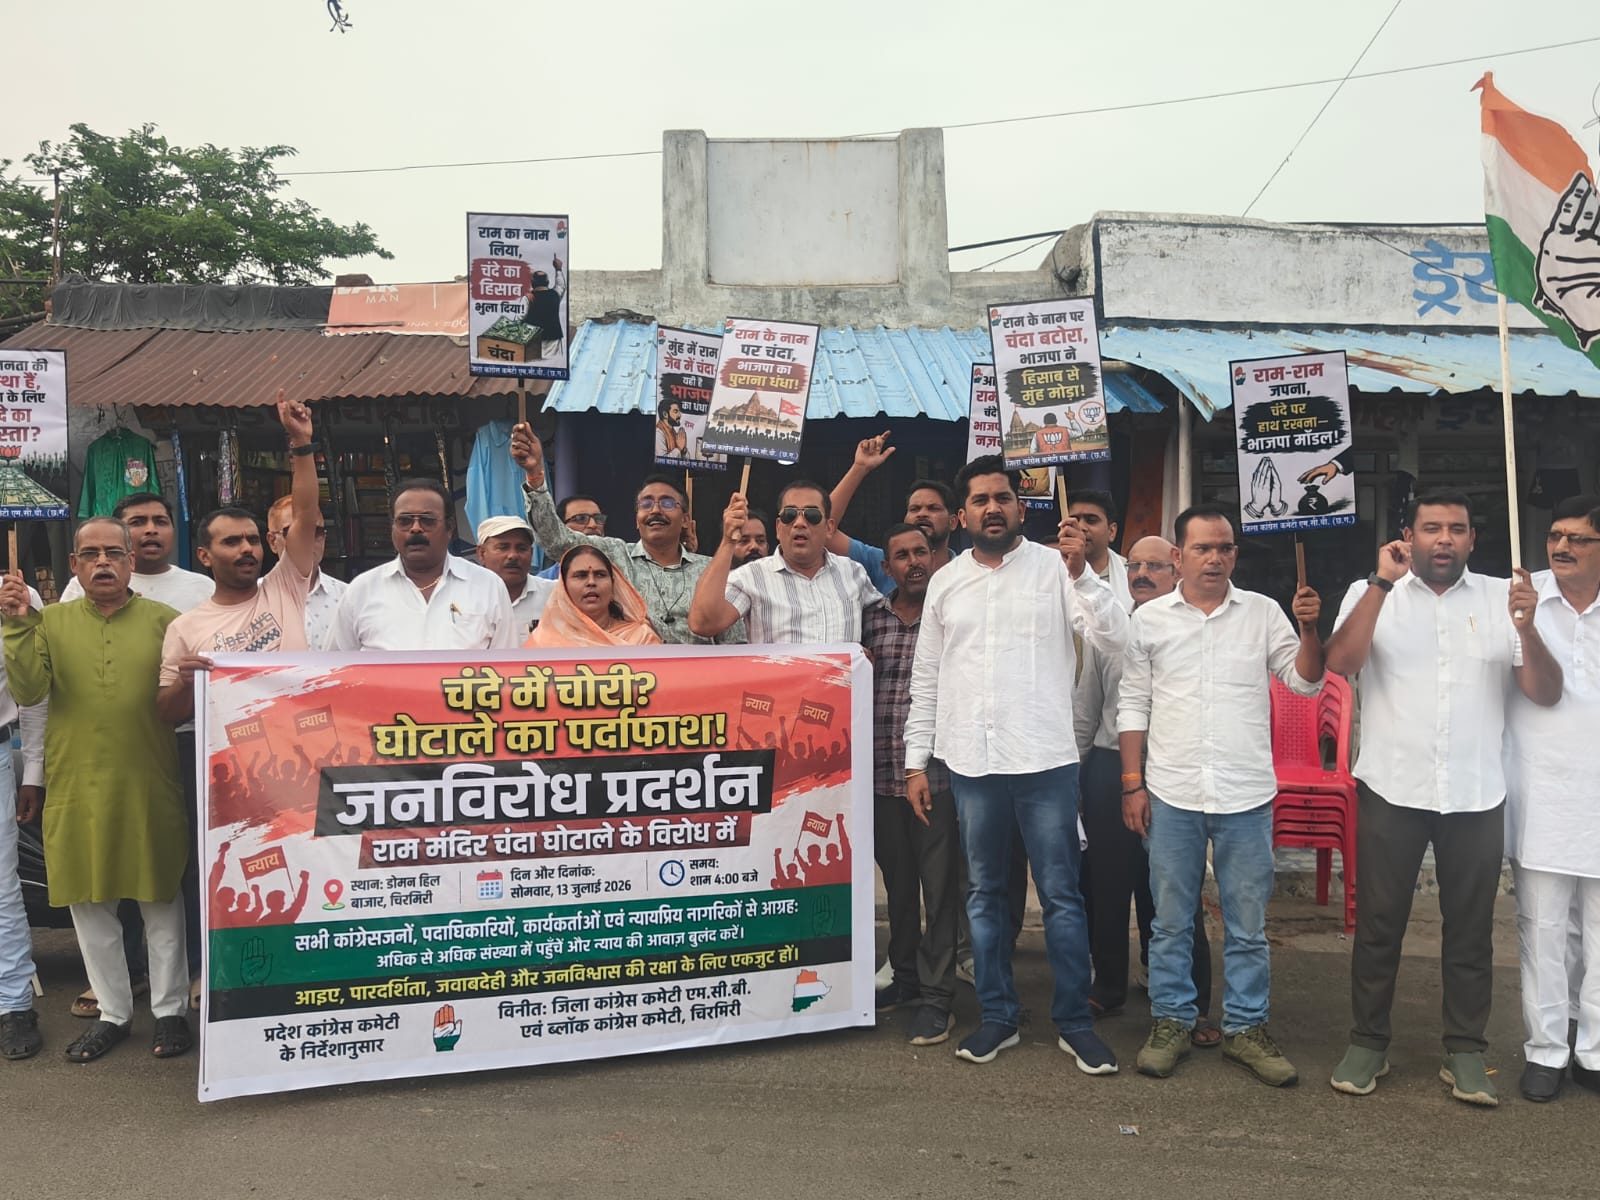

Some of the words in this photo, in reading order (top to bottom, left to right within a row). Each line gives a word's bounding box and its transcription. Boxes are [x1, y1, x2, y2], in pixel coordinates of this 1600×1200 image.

[478, 226, 502, 239] राम
[504, 227, 520, 240] का
[523, 228, 550, 241] नाम
[489, 241, 523, 259] लिया,
[480, 261, 501, 278] चंदे
[503, 264, 521, 278] का
[480, 278, 523, 296] हिसाब
[366, 295, 399, 304] MAN
[475, 302, 498, 315] भुला
[500, 302, 525, 314] दिया!
[1003, 315, 1024, 328] राम
[1027, 312, 1038, 326] के
[1041, 312, 1068, 324] नाम
[1069, 311, 1085, 322] पर
[735, 328, 759, 341] राम
[763, 328, 776, 341] के
[779, 333, 810, 345] नाम
[1005, 331, 1035, 348] चंदा
[1039, 327, 1088, 346] बटोरा,
[488, 343, 516, 361] चंदा
[668, 338, 685, 356] मुंह
[687, 341, 698, 356] में
[699, 345, 718, 359] राम
[741, 343, 762, 355] पर
[765, 345, 797, 362] चंदा,
[1019, 350, 1061, 365] भाजपा
[1064, 346, 1077, 361] ने
[32, 358, 48, 372] की
[664, 352, 681, 370] जेब
[684, 357, 695, 372] में
[737, 361, 774, 373] भाजपा
[776, 365, 793, 375] का
[24, 372, 41, 390] हैं,
[729, 373, 767, 387] पुराना
[769, 375, 800, 389] धंधा!
[1021, 370, 1063, 386] हिसाब
[1067, 365, 1080, 382] से
[1253, 362, 1325, 382] राम-राम
[682, 376, 696, 386] यही
[697, 377, 704, 387] है
[1269, 382, 1311, 396] जपना,
[7, 390, 19, 402] के
[21, 390, 46, 403] लिए
[671, 385, 712, 400] भाजप
[1021, 388, 1044, 405] मुंह
[1047, 384, 1085, 402] मोड़ा!
[12, 408, 32, 422] का
[681, 401, 692, 411] का
[1270, 402, 1288, 416] चंदे
[1291, 403, 1306, 414] पर
[1257, 420, 1279, 432] हाथ
[1248, 436, 1290, 451] भाजपा
[1294, 429, 1339, 447] मॉडल!
[441, 665, 503, 711] चंदे
[510, 663, 553, 710] में
[555, 662, 657, 709] चोरी?
[745, 696, 772, 713] न्याय
[802, 704, 829, 722] न्याय
[297, 711, 328, 728] न्याय
[229, 721, 261, 740] न्याय
[372, 713, 498, 758] घोटाले
[502, 719, 560, 754] का
[564, 707, 728, 751] पर्दाफाश!
[332, 762, 592, 826] जनविरोध
[602, 755, 763, 815] प्रदर्शन
[806, 816, 828, 834] न्याय
[371, 838, 420, 864] राम
[424, 831, 489, 860] मंदिर
[493, 827, 537, 856] चंदा
[542, 821, 614, 854] घोटाले
[619, 820, 643, 848] के
[648, 820, 711, 847] विरोध
[714, 815, 740, 842] में
[245, 851, 280, 872] न्याय
[689, 858, 720, 870] समय:
[511, 867, 531, 882] दिन
[534, 865, 555, 880] और
[558, 864, 596, 879] दिनांक:
[690, 873, 711, 887] शाम
[714, 872, 740, 885] 4:00
[742, 869, 759, 884] बजे
[350, 877, 384, 892] स्थान:
[385, 875, 416, 890] डोमन
[418, 873, 441, 888] हिल
[510, 883, 554, 900] सोमवार,
[557, 884, 569, 896] 13
[572, 880, 602, 898] जुलाई
[604, 879, 632, 893] 2026
[350, 895, 388, 911] बाजार,
[390, 890, 433, 909] चिरमिरी
[294, 928, 329, 952] सभी
[333, 922, 418, 950] कांग्रेसजनों,
[421, 915, 520, 943] पदाधिकारियों,
[523, 909, 601, 935] कार्यकर्ताओं
[604, 906, 625, 928] एवं
[627, 903, 684, 926] न्यायप्रिय
[686, 899, 744, 922] नागरिकों
[745, 898, 758, 918] से
[761, 898, 799, 916] आग्रह:
[376, 950, 417, 968] अधिक
[420, 948, 433, 965] से
[437, 944, 478, 964] अधिक
[480, 941, 518, 960] संख्या
[520, 938, 534, 957] में
[535, 936, 565, 960] पहुँचें
[567, 935, 591, 953] और
[594, 935, 623, 951] न्याय
[626, 930, 643, 948] की
[646, 929, 685, 947] आवाज़
[688, 926, 717, 947] बुलंद
[719, 924, 744, 941] करें।
[295, 988, 345, 1006] आइए,
[349, 976, 432, 1001] पारदर्शिता,
[435, 971, 507, 994] जवाबदेही
[510, 968, 539, 987] और
[543, 960, 621, 984] जनविश्वास
[625, 957, 646, 977] की
[649, 957, 677, 976] रक्षा
[680, 955, 696, 973] के
[698, 951, 727, 971] लिए
[731, 949, 776, 969] एकजुट
[779, 945, 800, 963] हों।
[498, 998, 547, 1020] विनीत:
[551, 994, 589, 1015] जिला
[594, 989, 638, 1011] कांग्रेस
[642, 986, 682, 1006] कमेटी
[685, 979, 752, 1001] एम.सी.बी.
[263, 1021, 301, 1044] प्रदेश
[305, 1016, 353, 1039] कांग्रेस
[357, 1013, 400, 1033] कमेटी
[520, 1019, 542, 1039] एवं
[547, 1012, 589, 1036] ब्लॉक
[593, 1010, 638, 1033] कांग्रेस
[642, 1006, 687, 1027] कमेटी,
[690, 1000, 742, 1024] चिरमिरी
[279, 1043, 297, 1063] के
[300, 1036, 384, 1060] निर्देशानुसार
